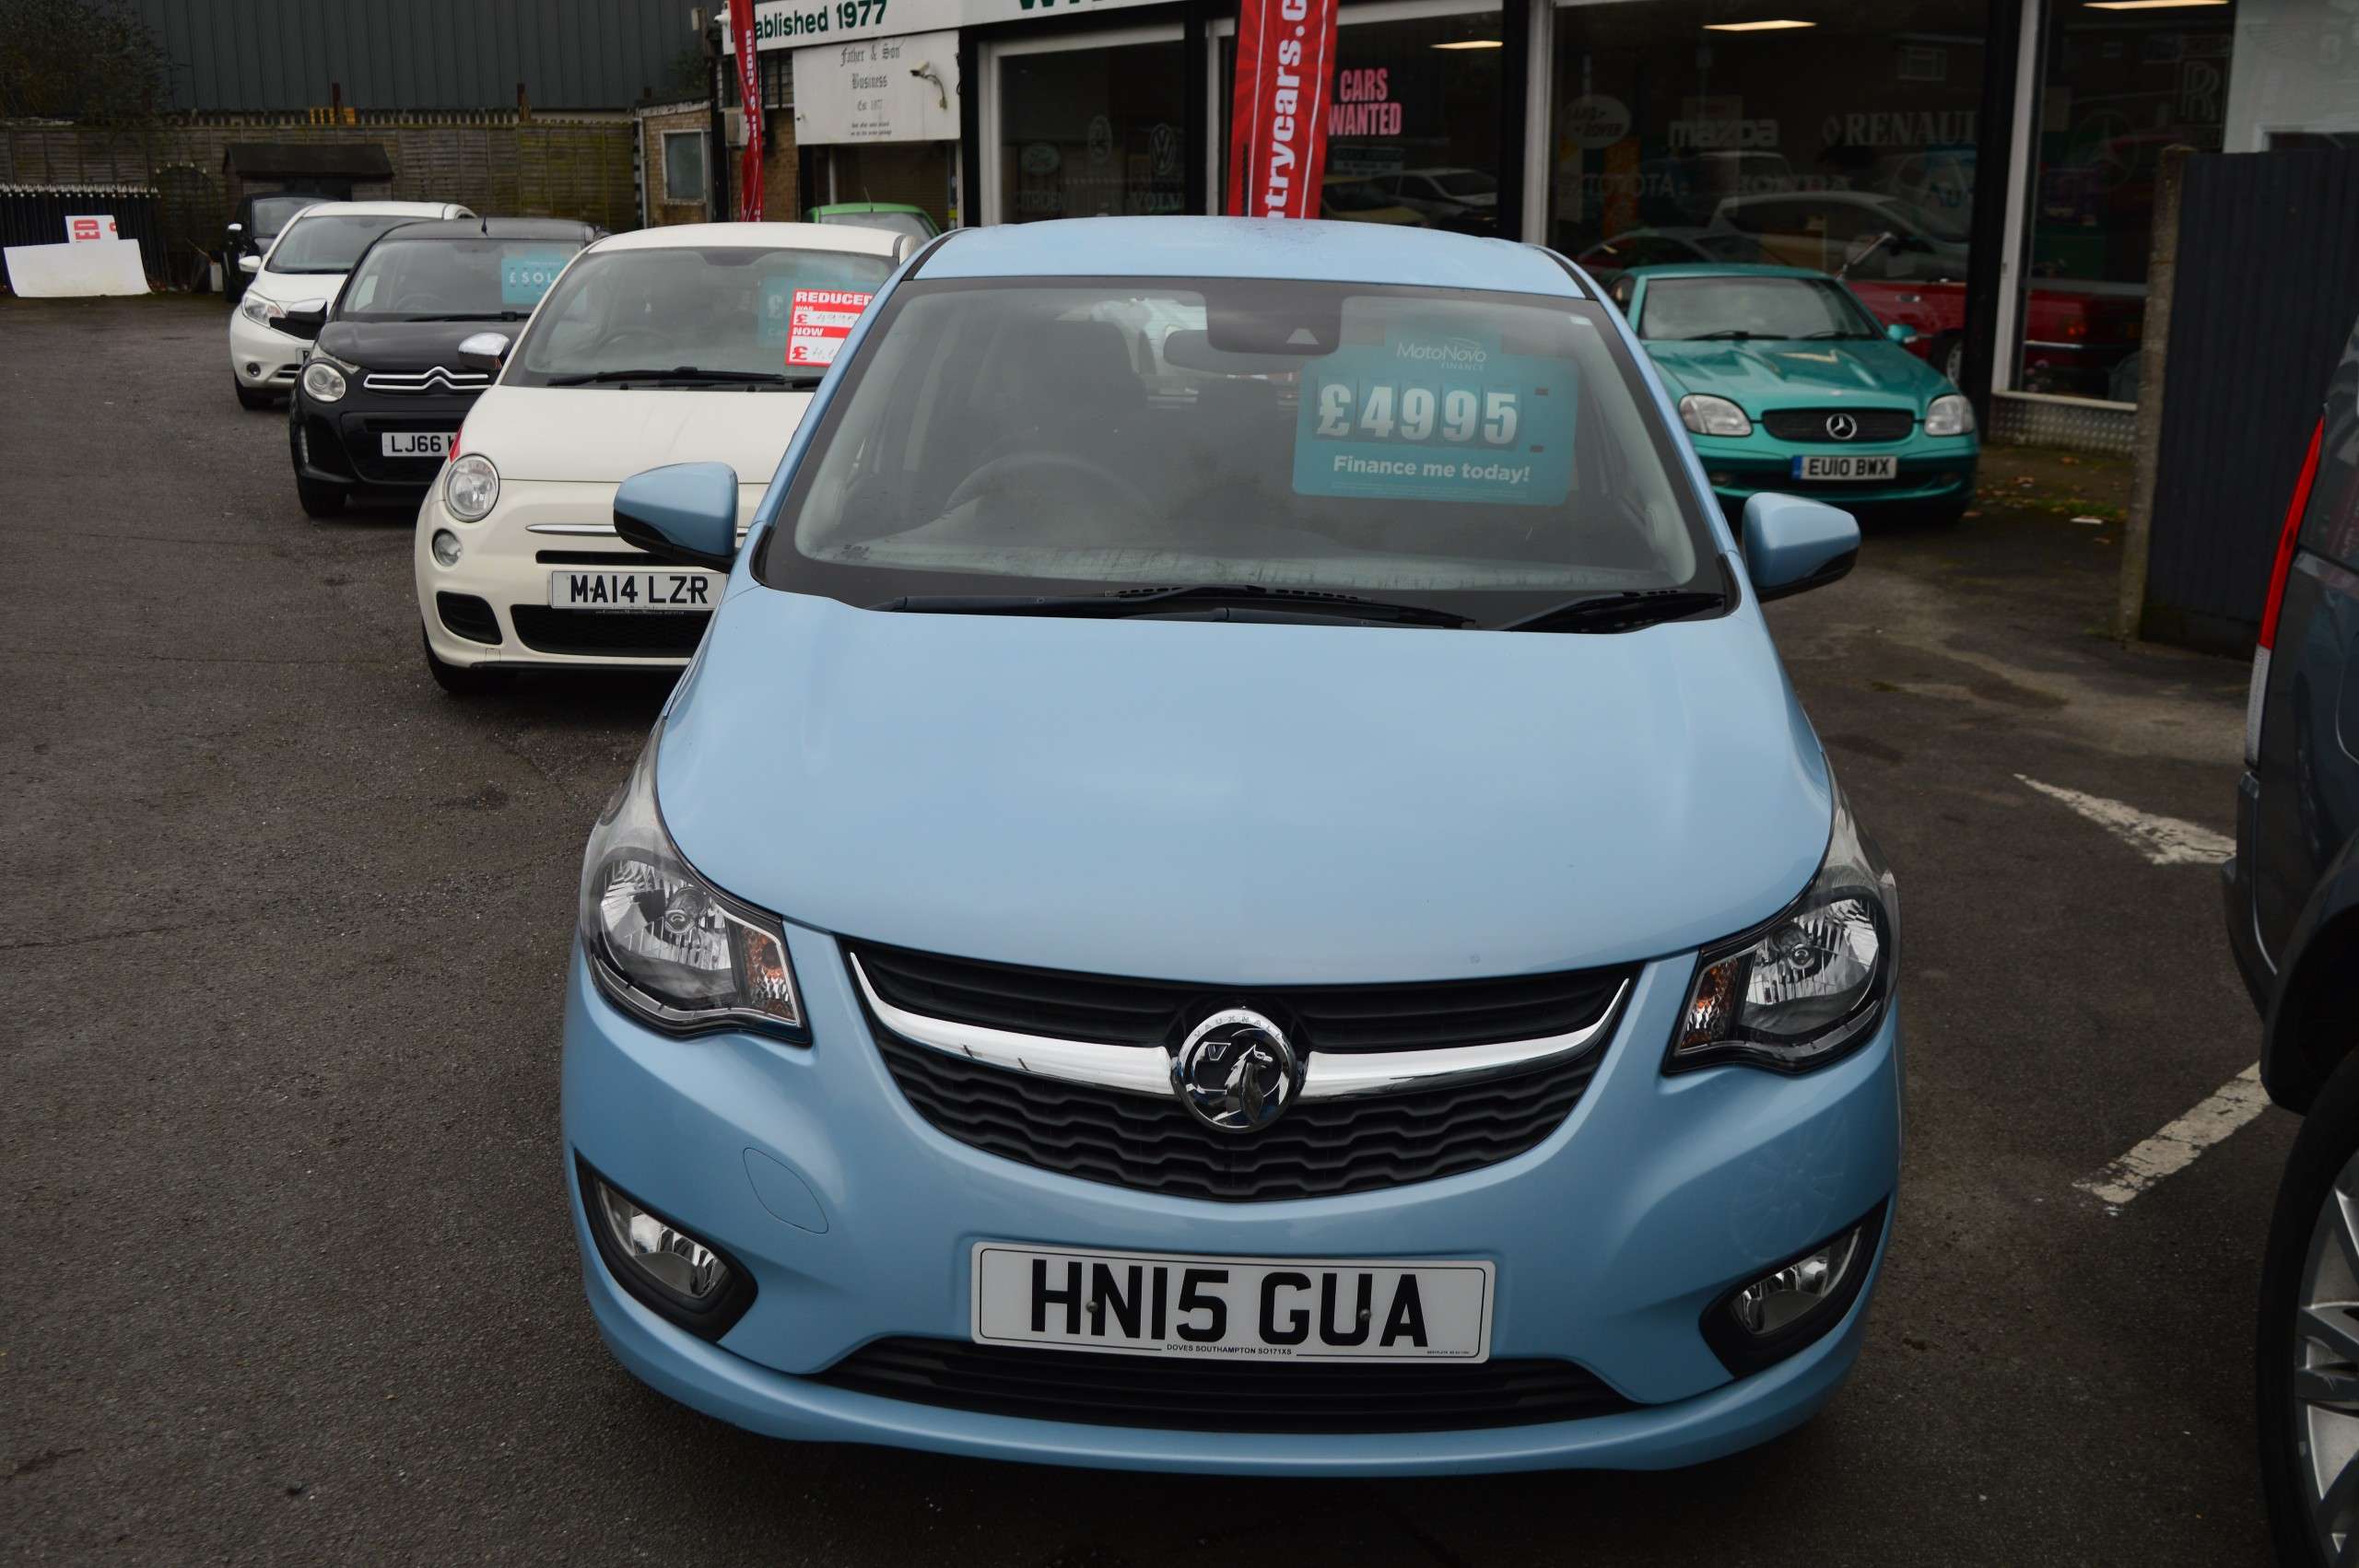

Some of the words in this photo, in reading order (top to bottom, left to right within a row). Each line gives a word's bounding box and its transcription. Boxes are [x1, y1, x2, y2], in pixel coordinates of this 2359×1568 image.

[756, 6, 828, 41] ablished
[836, 0, 887, 29] 1977
[1340, 67, 1388, 100] CARS
[1329, 102, 1402, 136] WANTED
[1668, 118, 1780, 148] mazda
[792, 326, 825, 337] NOW
[792, 345, 808, 361] £
[1396, 342, 1487, 362] MotoNovo
[1316, 383, 1518, 445] £4995
[391, 435, 442, 453] LJ66
[1333, 454, 1416, 477] Finance
[1422, 462, 1455, 478] me
[1461, 462, 1531, 486] today!
[1855, 459, 1889, 476] BWX
[570, 575, 638, 603] MA14
[648, 575, 709, 604] LZR
[1193, 1015, 1284, 1039] VAUXHALL
[1030, 1258, 1229, 1343] HN15
[1259, 1271, 1429, 1349] GUA
[1195, 1345, 1256, 1354] SOUTHAMPTON
